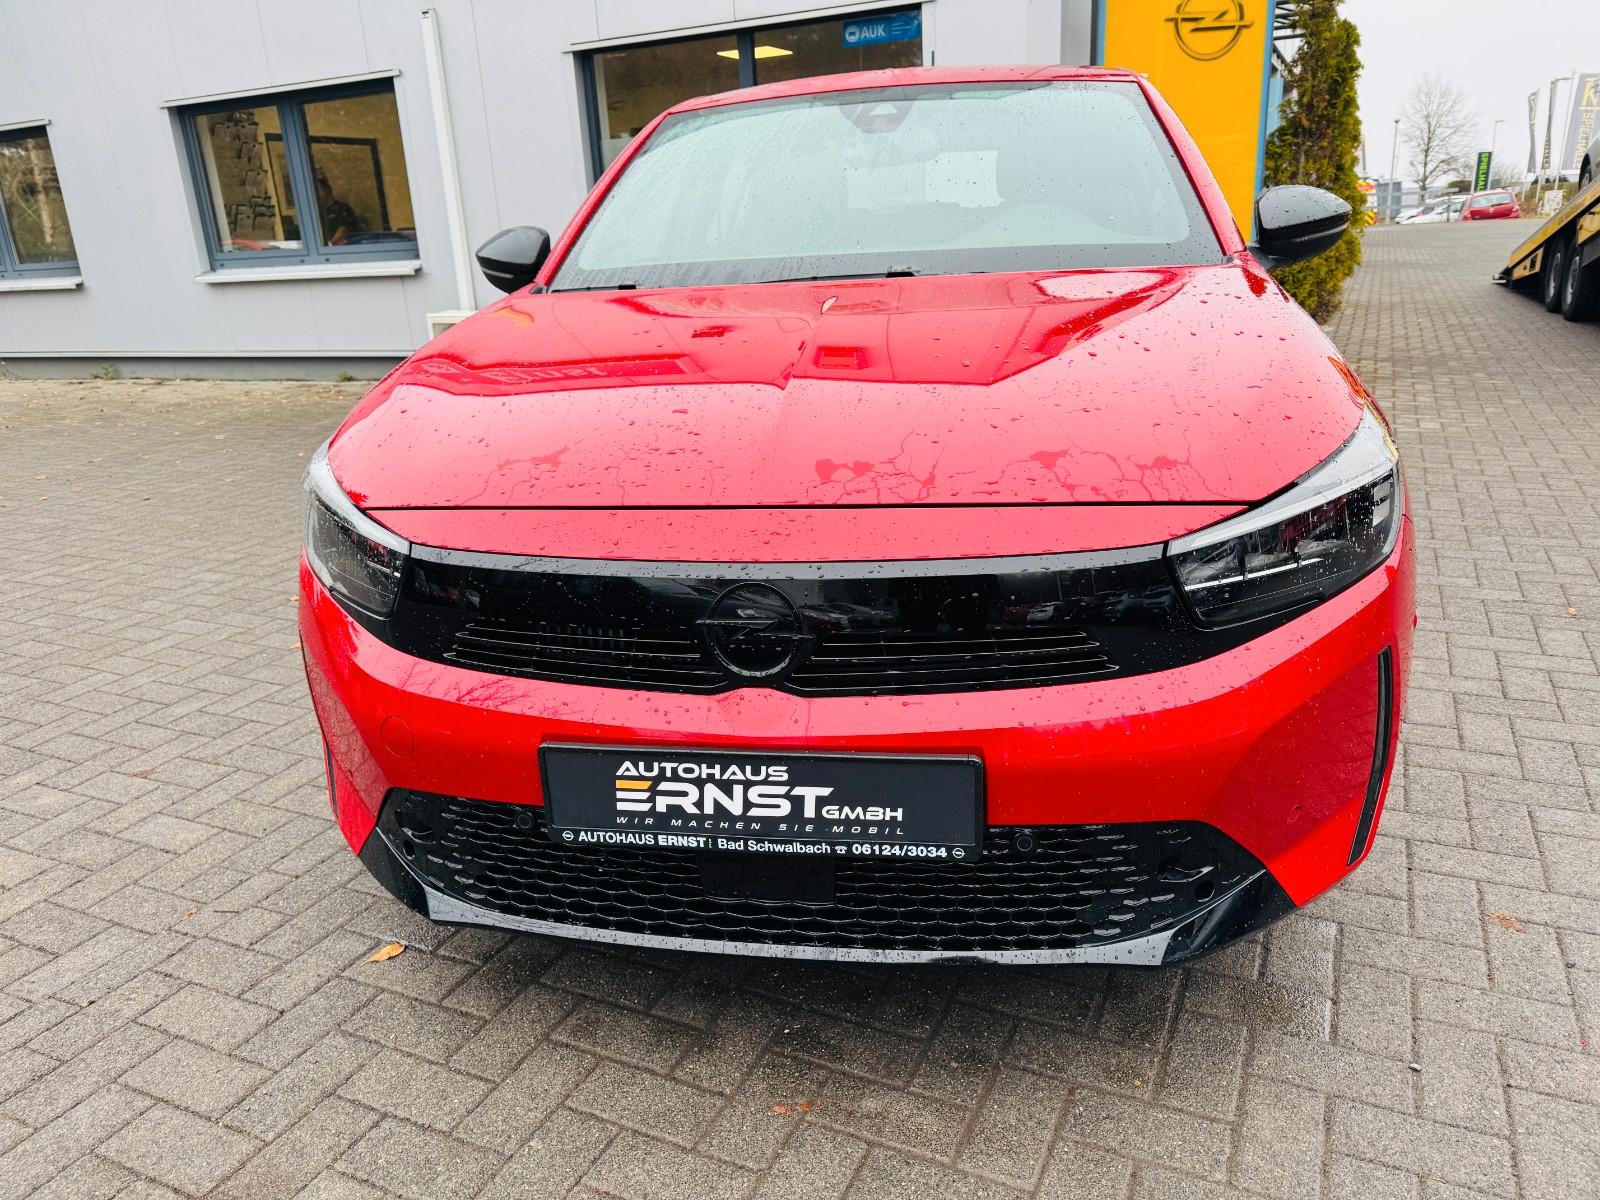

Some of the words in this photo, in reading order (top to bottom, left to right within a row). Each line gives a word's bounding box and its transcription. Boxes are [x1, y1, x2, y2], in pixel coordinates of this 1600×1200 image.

[861, 24, 885, 39] AUK
[615, 760, 789, 781] AUTOHAUS
[615, 780, 835, 819] ERNST
[821, 805, 904, 821] GMBH
[616, 816, 654, 825] WIR
[670, 819, 761, 830] MACHEN
[779, 823, 815, 832] SIE
[832, 825, 904, 835] MOBIL
[578, 831, 655, 845] AUTOHAUS
[657, 834, 707, 848] ERNST
[717, 838, 744, 851] Bad
[747, 839, 831, 855] Schwalbach
[852, 843, 948, 858] 06124/3034
